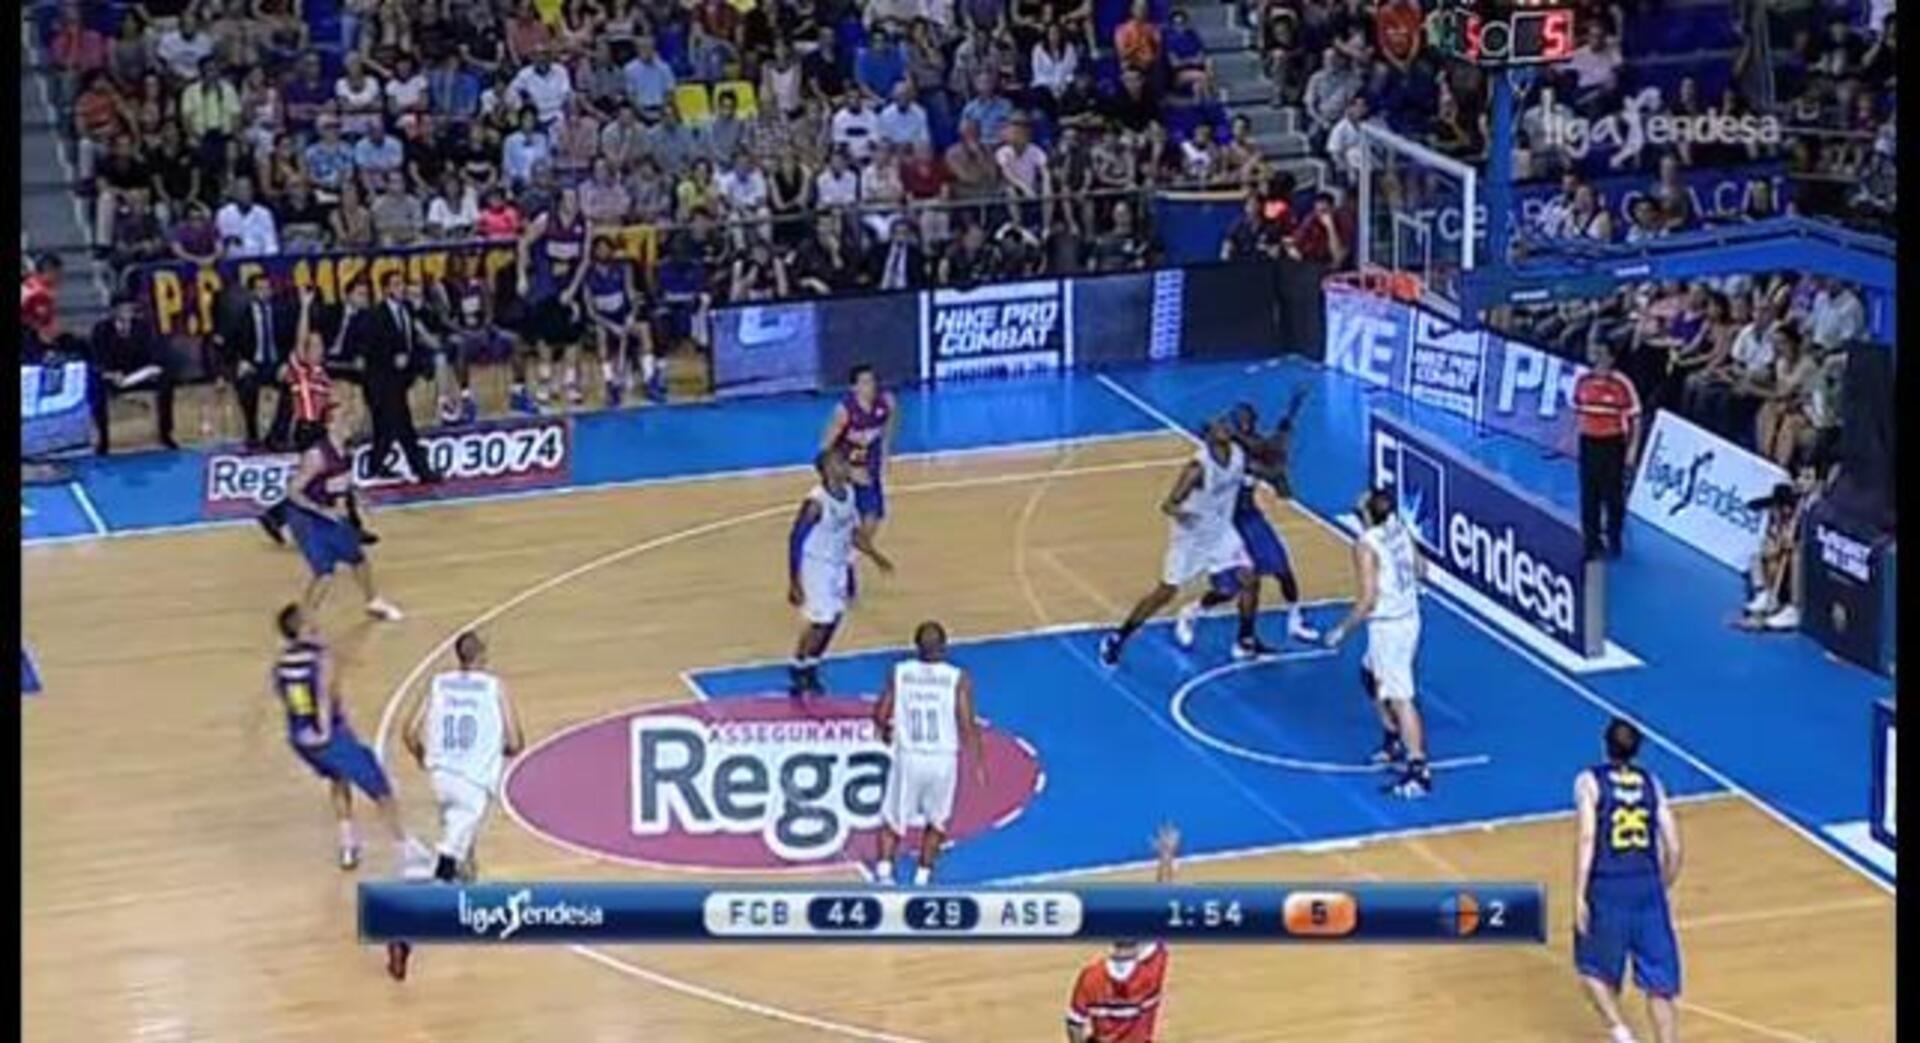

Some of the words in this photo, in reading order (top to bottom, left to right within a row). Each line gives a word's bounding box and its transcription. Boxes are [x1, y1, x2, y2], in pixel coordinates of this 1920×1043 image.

[935, 306, 999, 334] NIKE
[1002, 300, 1058, 330] PRO
[940, 325, 1050, 355] COMBAT
[515, 428, 561, 465] 74
[1450, 512, 1574, 633] endesa
